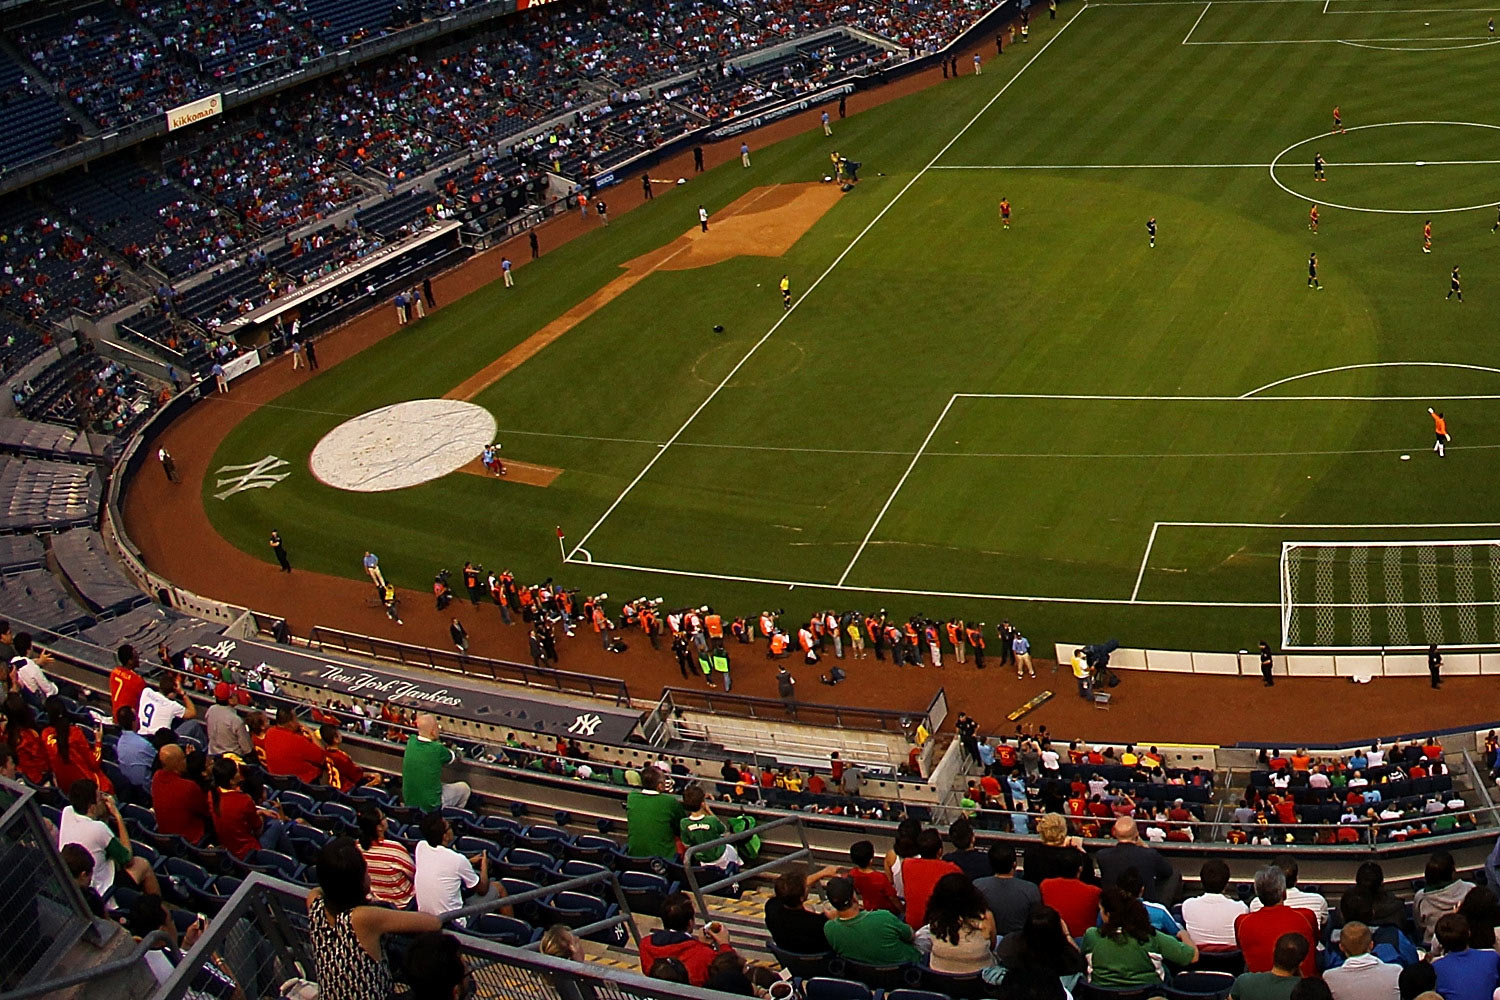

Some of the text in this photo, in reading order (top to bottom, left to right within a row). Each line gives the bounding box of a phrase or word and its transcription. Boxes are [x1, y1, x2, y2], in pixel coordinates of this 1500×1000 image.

[173, 107, 214, 128] kikkoman
[114, 676, 123, 702] 7
[319, 664, 462, 708] New York Yankees
[142, 703, 155, 728] 9
